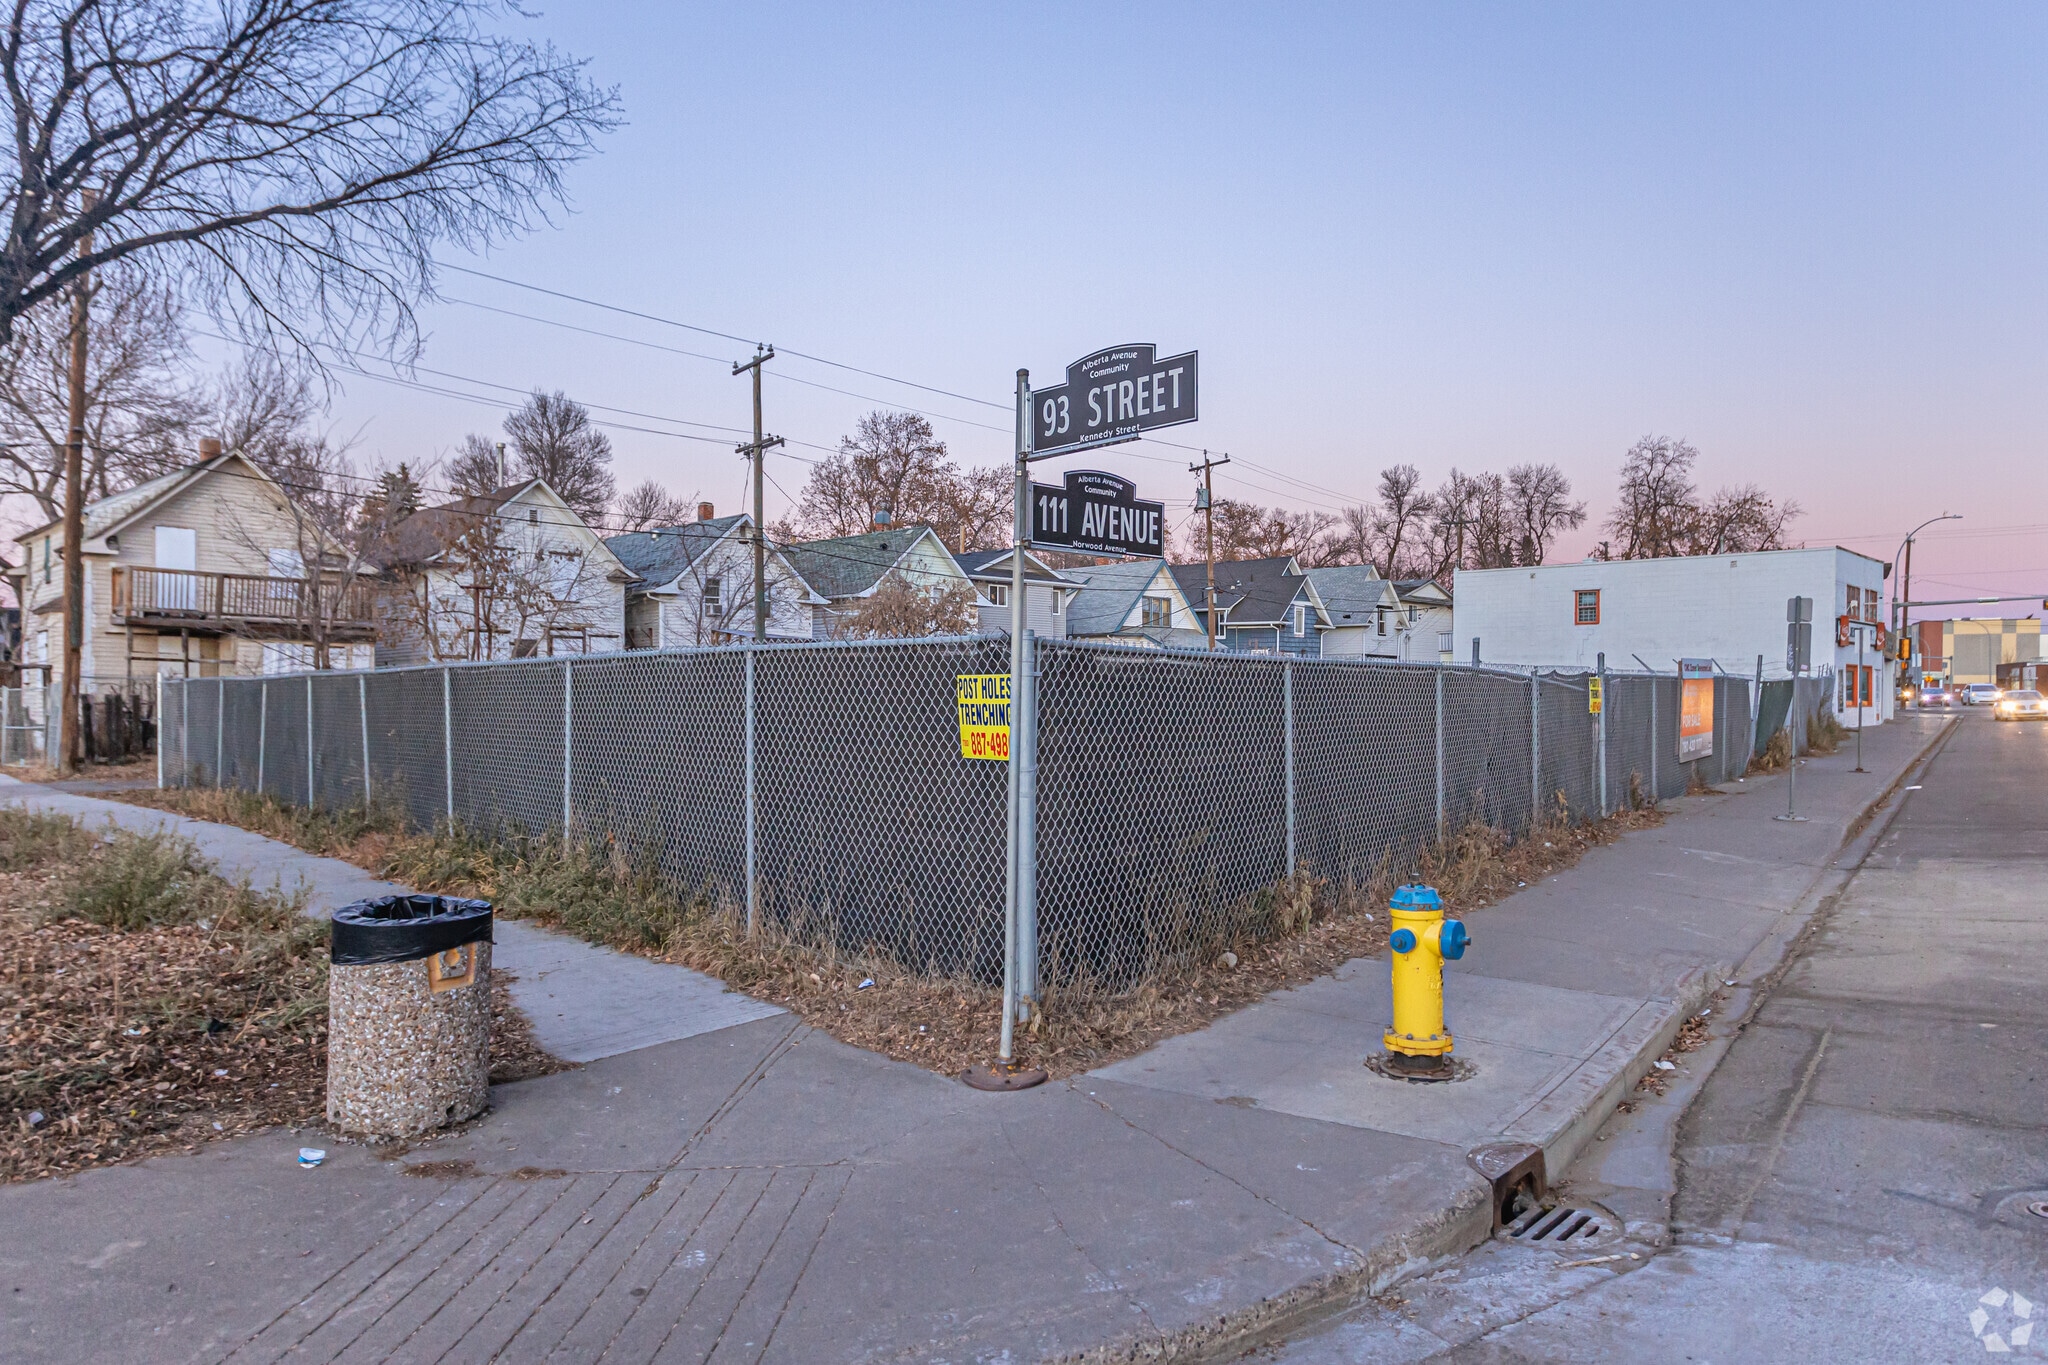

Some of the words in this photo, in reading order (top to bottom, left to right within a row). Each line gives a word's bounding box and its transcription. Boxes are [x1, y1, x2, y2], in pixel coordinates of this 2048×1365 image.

[1081, 355, 1109, 373] Alberta
[1110, 351, 1138, 361] Avenue
[1089, 363, 1130, 379] Community
[1042, 395, 1070, 437] 93
[1087, 366, 1184, 427] STREET
[1079, 429, 1114, 443] Kennedy
[1115, 423, 1141, 436] Street
[1078, 475, 1101, 483] Alberta
[1102, 478, 1124, 490] Avenue
[1084, 485, 1117, 498] Community
[1038, 495, 1068, 534] 111
[1081, 501, 1159, 545] AVENUE
[1072, 540, 1103, 551] Norwood
[1104, 543, 1127, 553] Avenue
[958, 677, 978, 699] POST
[981, 677, 1011, 699] HOLES
[970, 732, 1010, 757] 887-498
